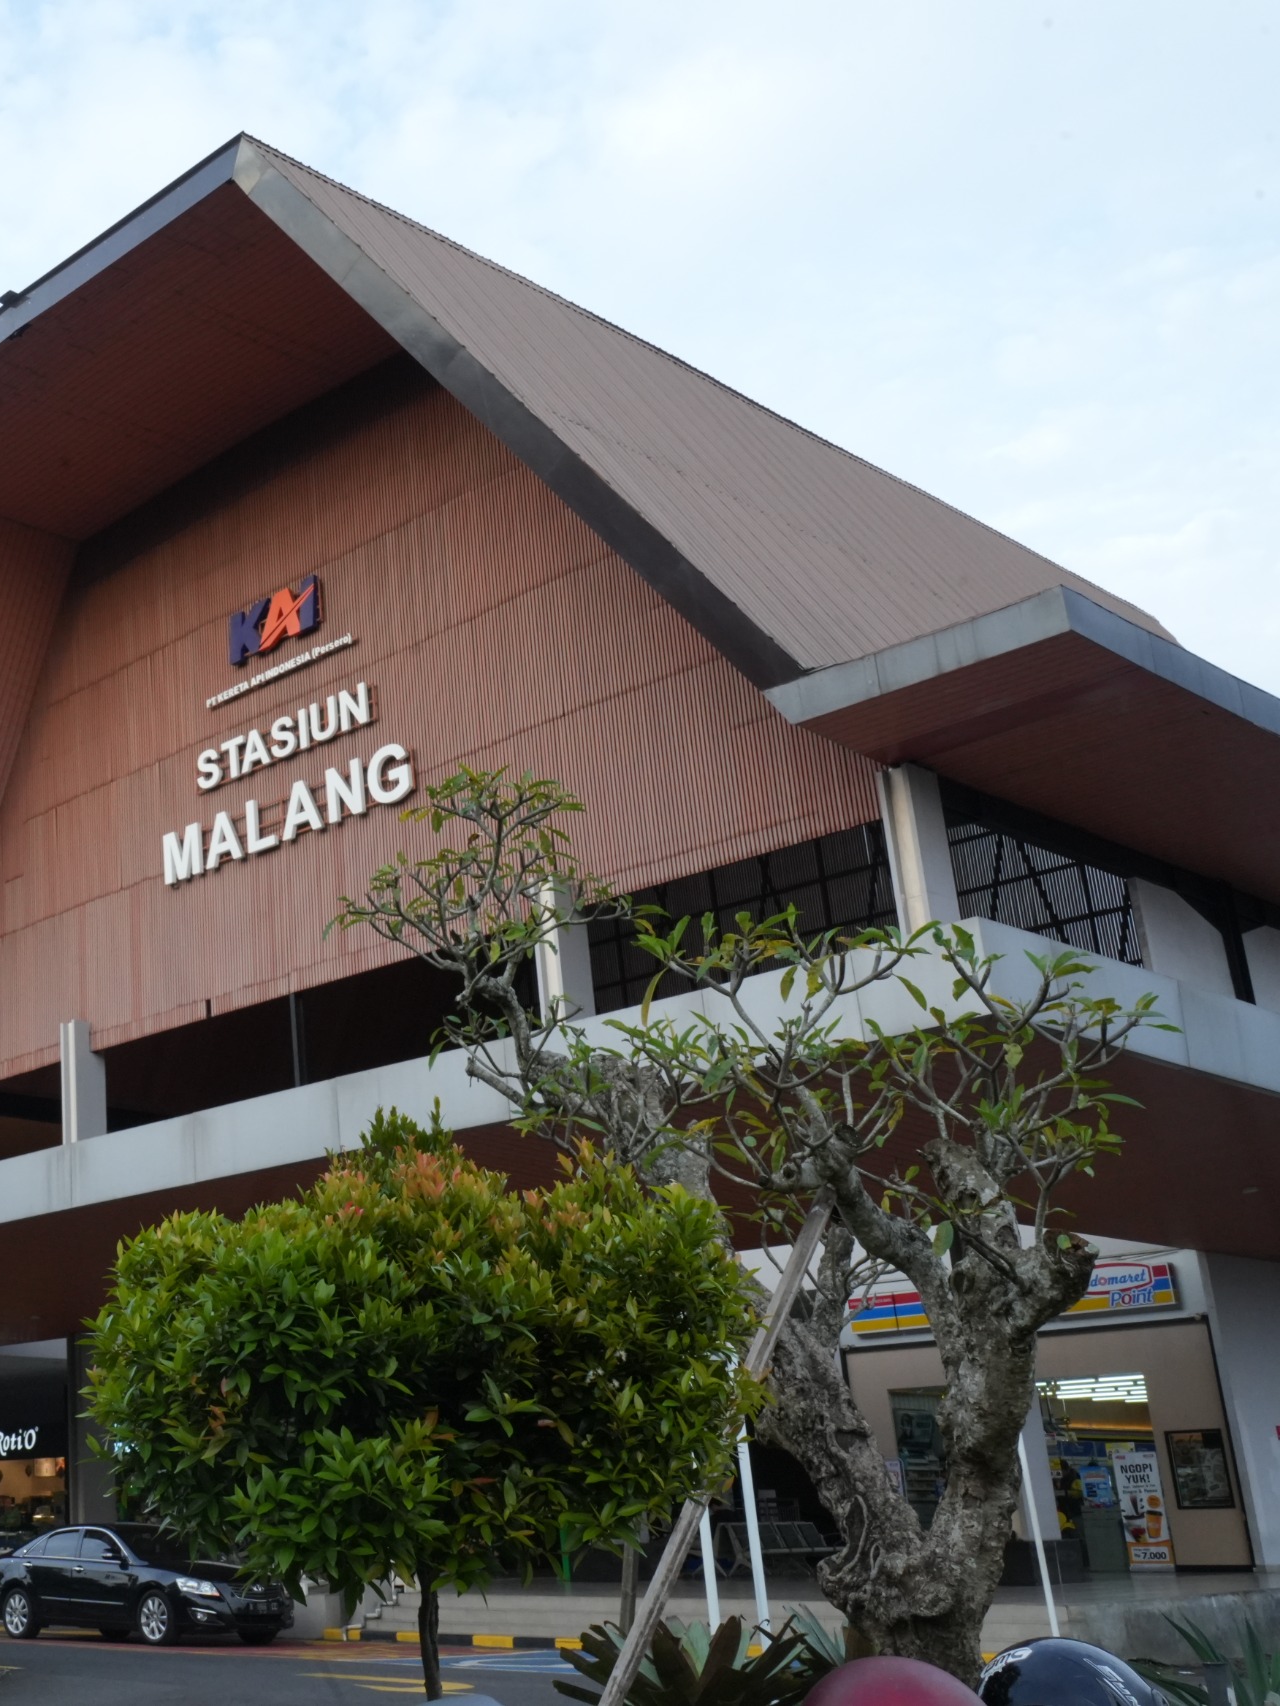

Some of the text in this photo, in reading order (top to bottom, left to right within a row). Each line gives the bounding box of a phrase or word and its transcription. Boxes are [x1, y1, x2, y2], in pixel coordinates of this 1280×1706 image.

[229, 574, 319, 666] KAI
[206, 633, 352, 708] PT KERETA API INDONESIA (Persero)
[196, 682, 371, 790] STASIUN
[162, 743, 414, 885] MALANG
[1090, 1269, 1146, 1287] domaret
[1111, 1287, 1154, 1307] Point
[1120, 1463, 1153, 1474] NGOPI
[1125, 1474, 1151, 1484] YUK!
[1141, 1551, 1167, 1560] 7.000
